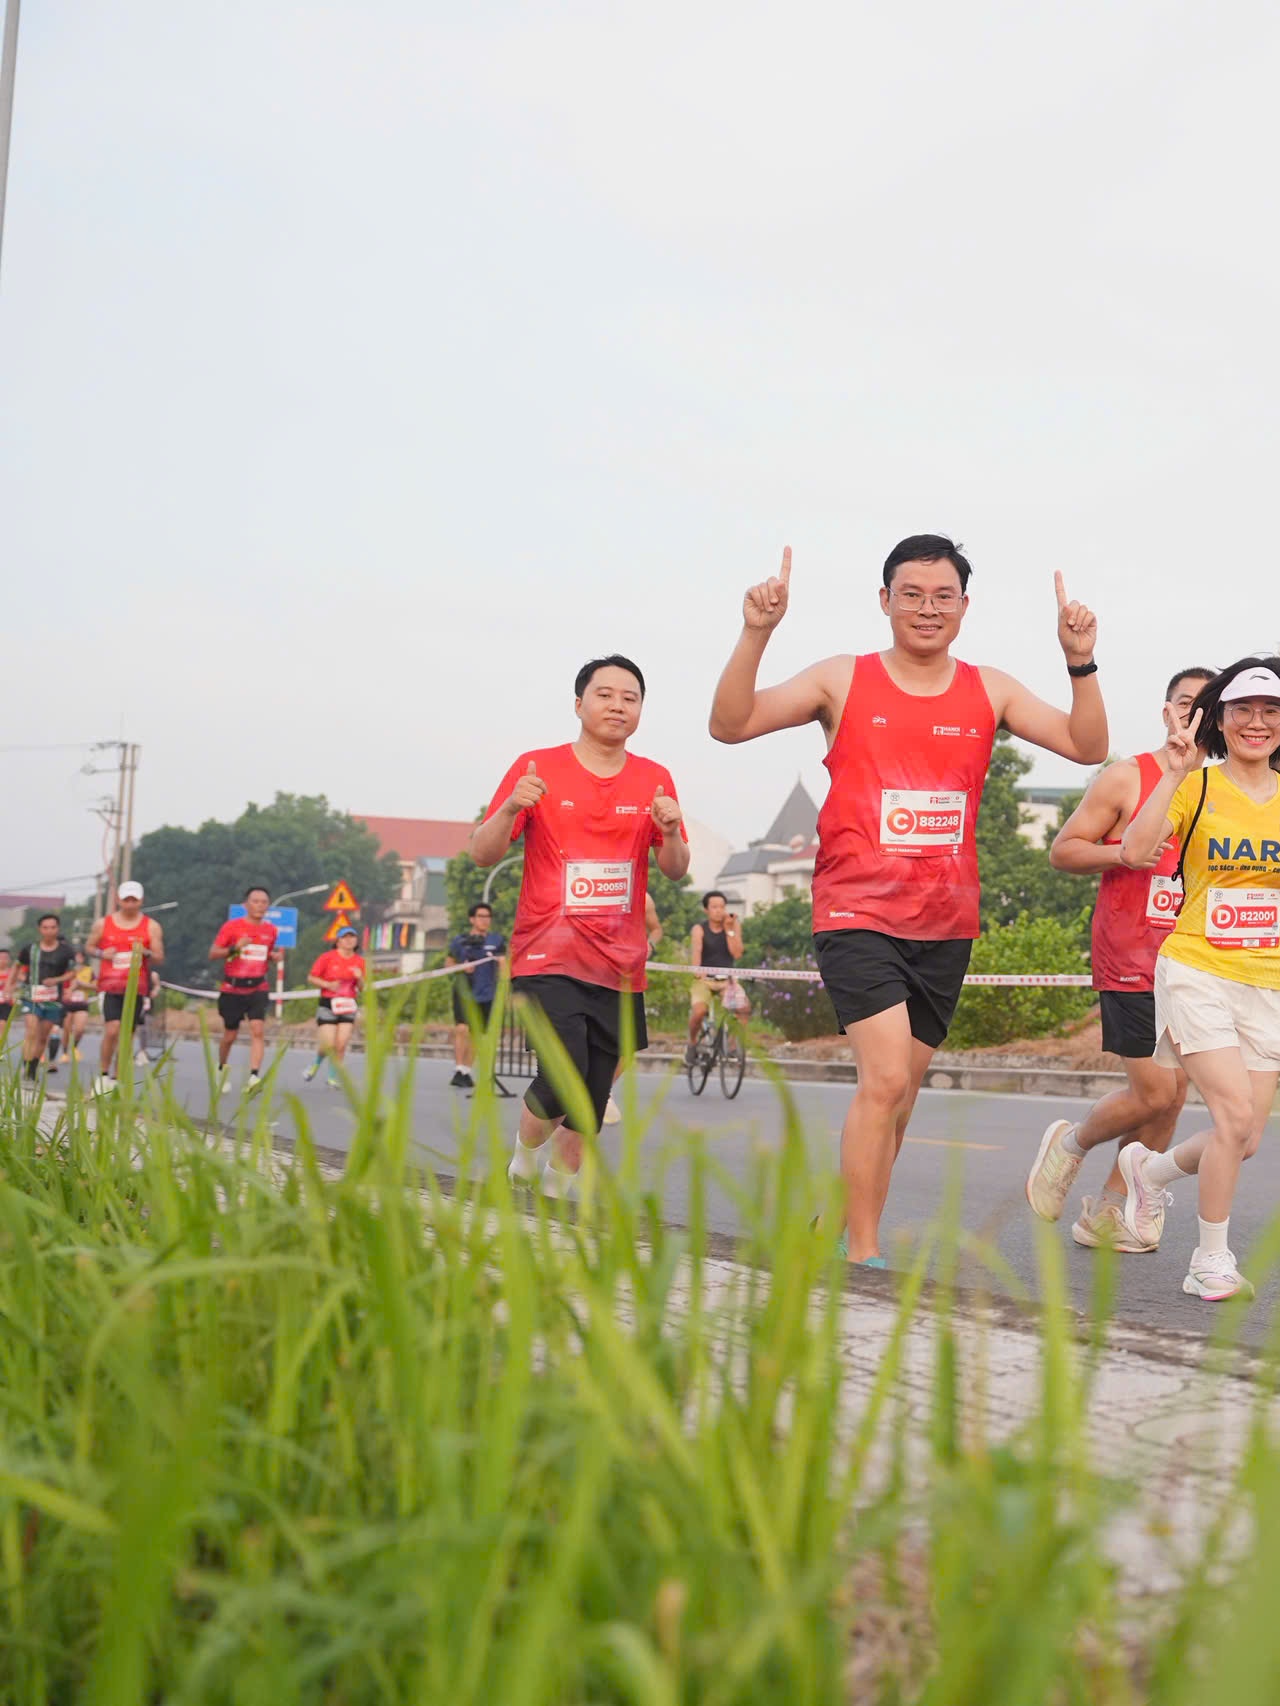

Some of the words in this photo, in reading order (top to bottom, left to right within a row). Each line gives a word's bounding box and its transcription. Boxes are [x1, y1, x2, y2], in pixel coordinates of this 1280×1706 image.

[893, 813, 909, 830] C
[919, 815, 959, 827] 882248
[576, 882, 588, 894] D
[1158, 894, 1169, 907] D
[1216, 909, 1231, 924] D
[1240, 911, 1275, 921] 822001
